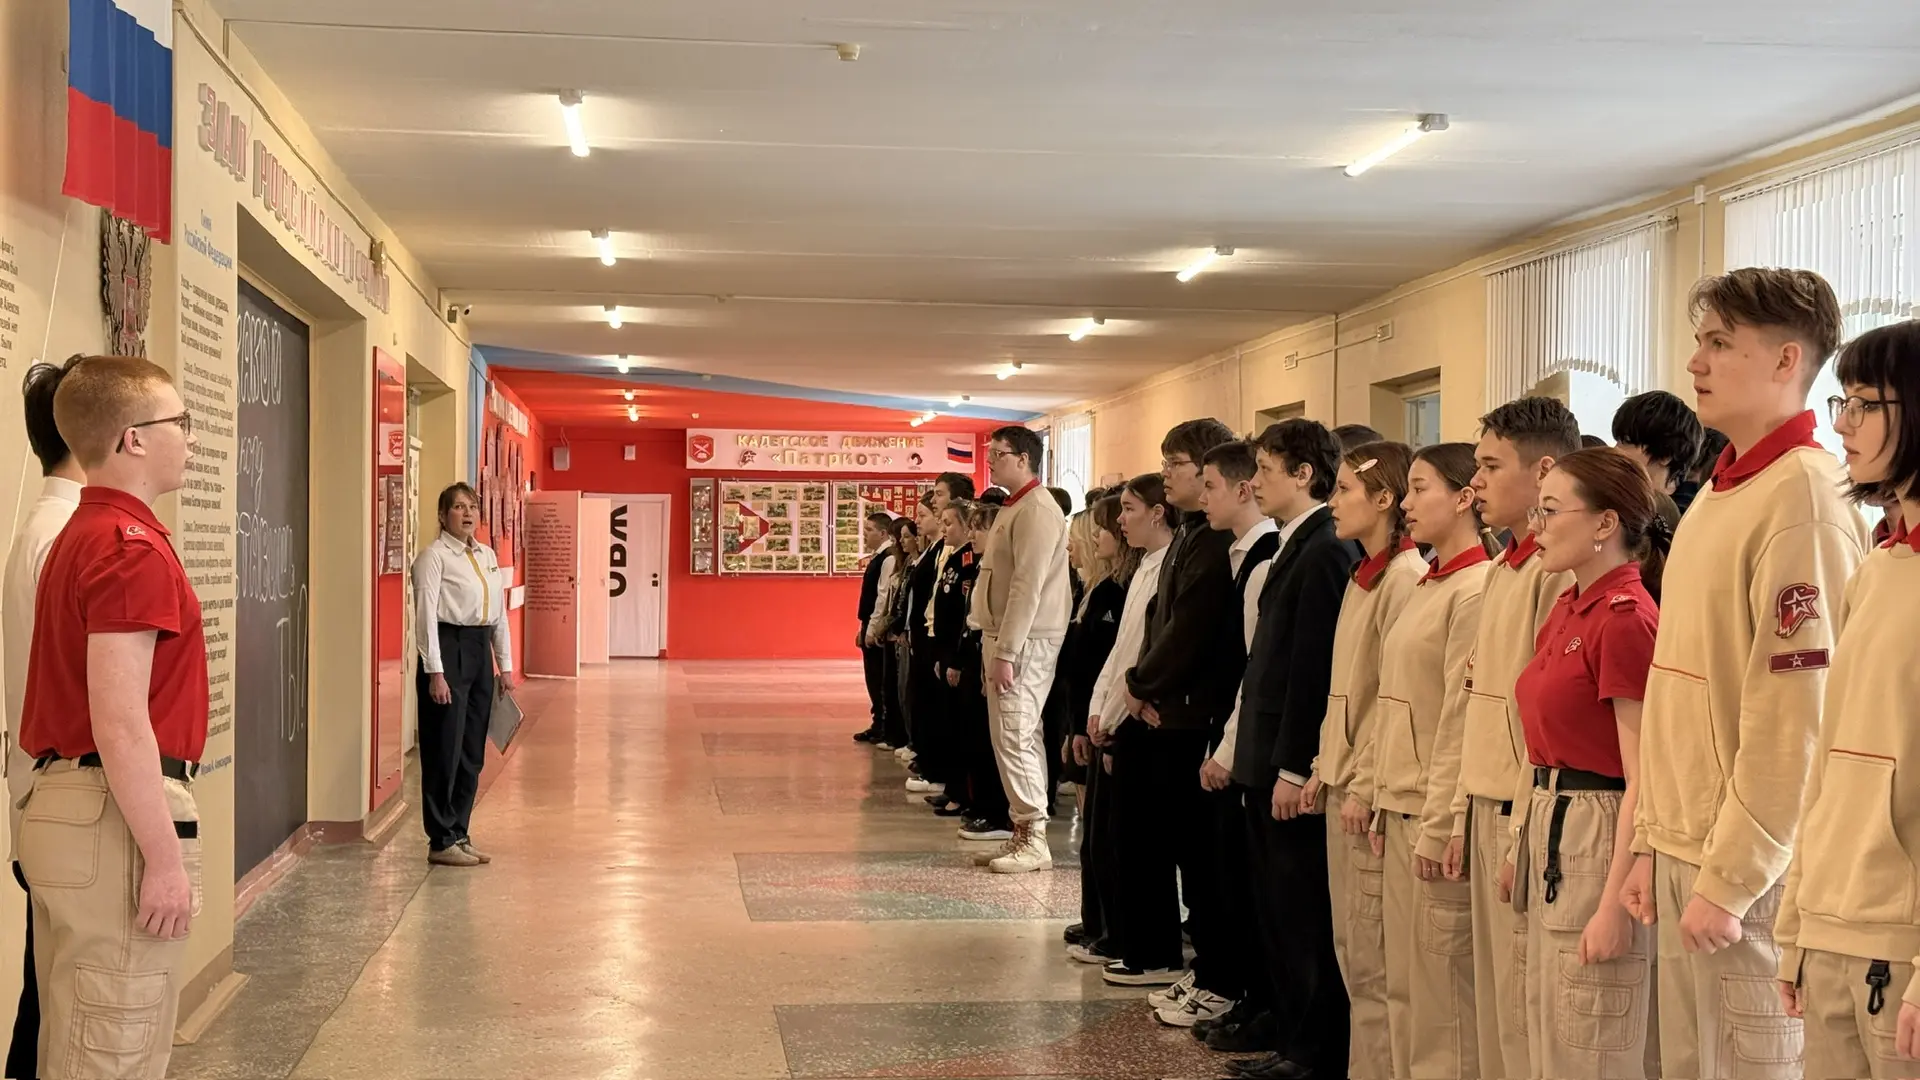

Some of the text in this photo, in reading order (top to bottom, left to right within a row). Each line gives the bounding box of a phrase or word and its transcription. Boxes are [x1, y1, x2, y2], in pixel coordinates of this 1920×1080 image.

[737, 435, 925, 448] КАДЕТСКОЕ ДВИЖЕНИЕ
[771, 449, 893, 467] «Патриот»
